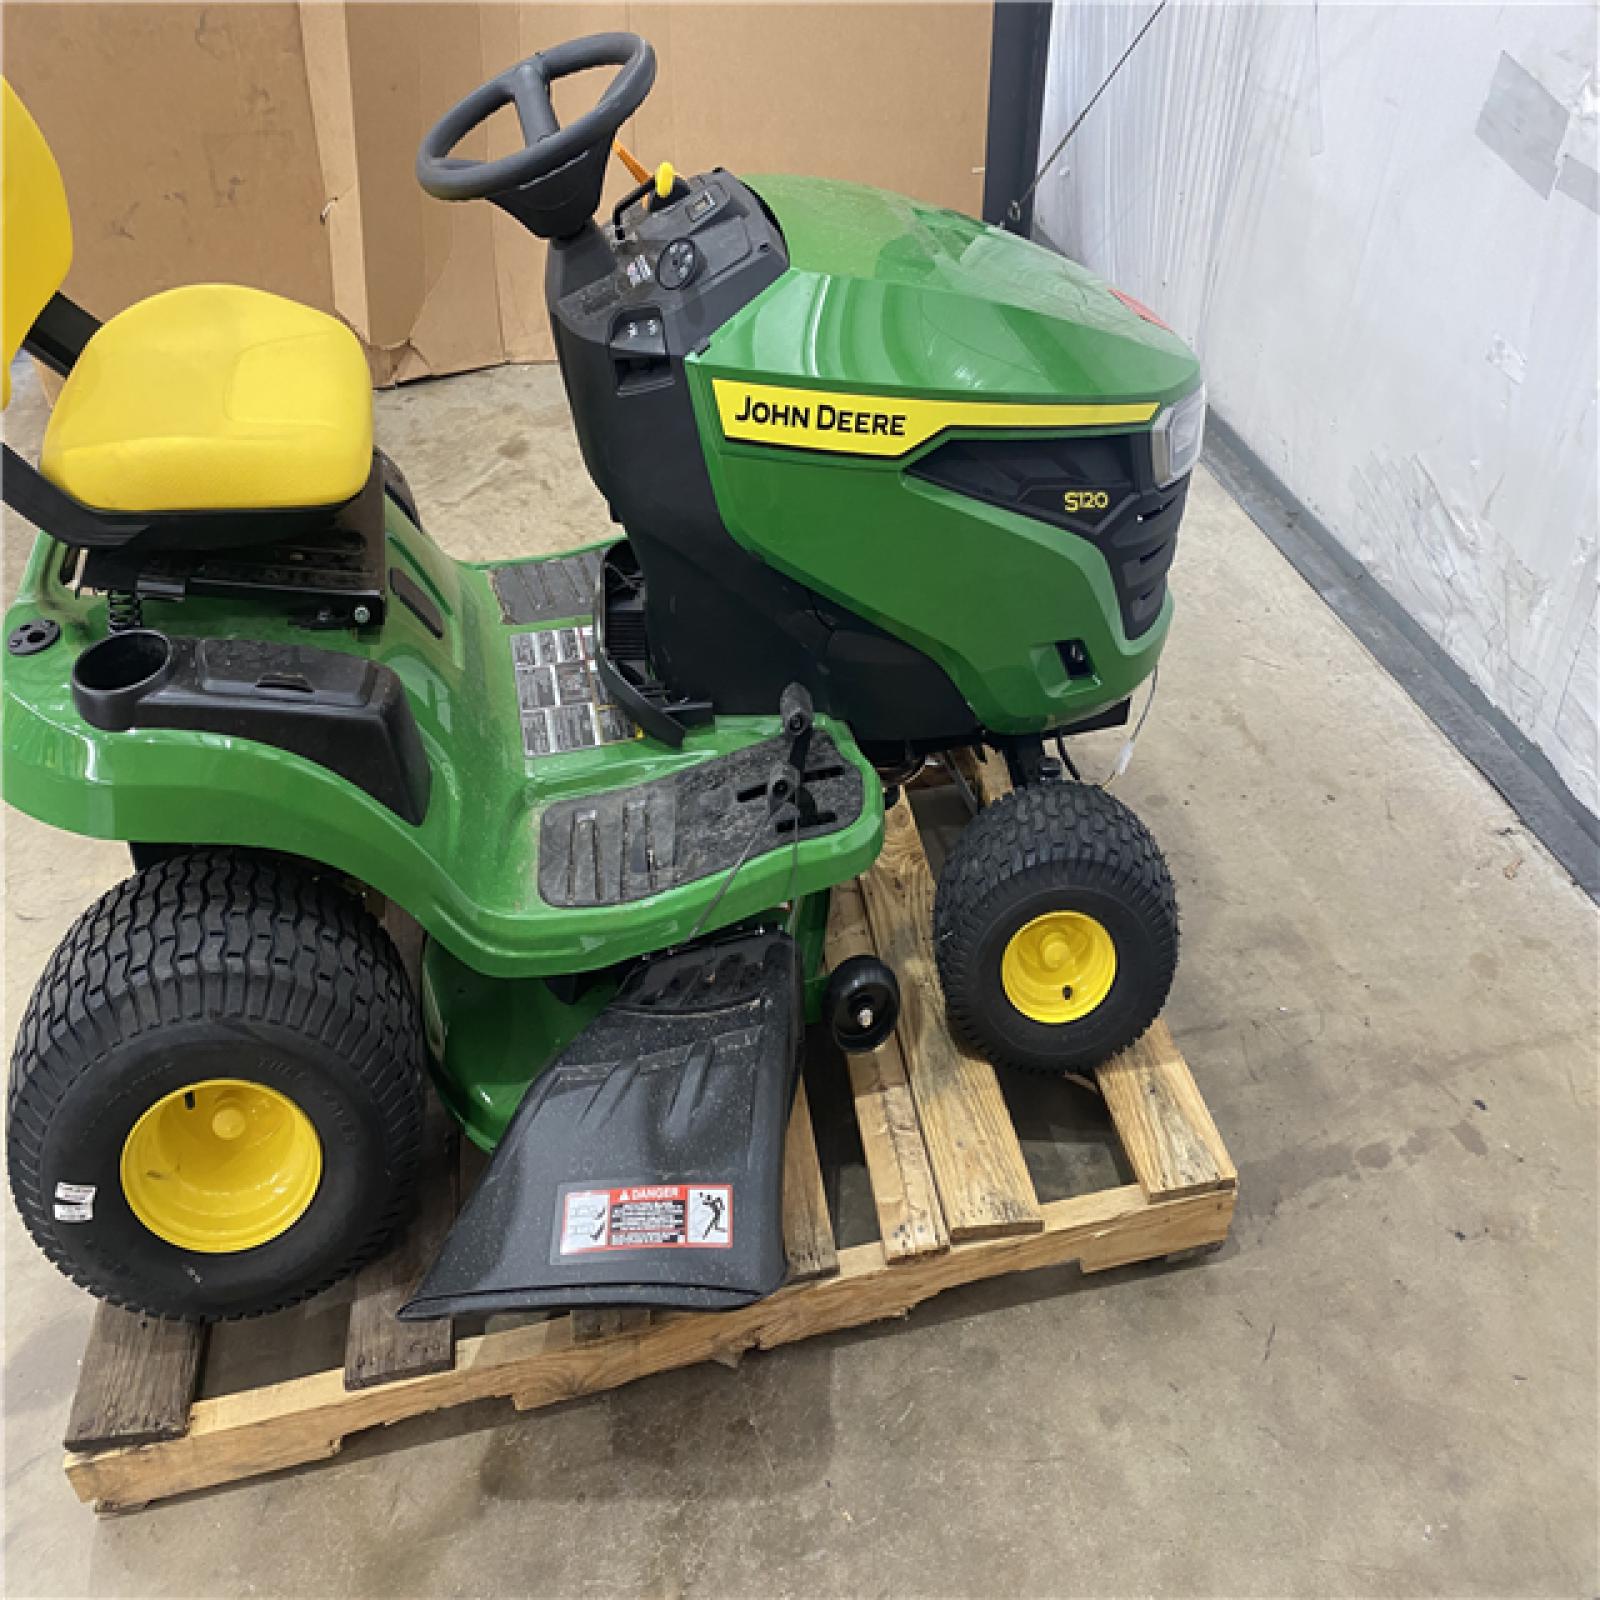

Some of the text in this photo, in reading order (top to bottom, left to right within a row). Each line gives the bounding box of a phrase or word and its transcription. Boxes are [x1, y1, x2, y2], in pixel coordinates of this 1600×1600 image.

[735, 396, 906, 437] JOHN DEERE
[1063, 490, 1109, 512] S120
[632, 1187, 680, 1200] DANGER
